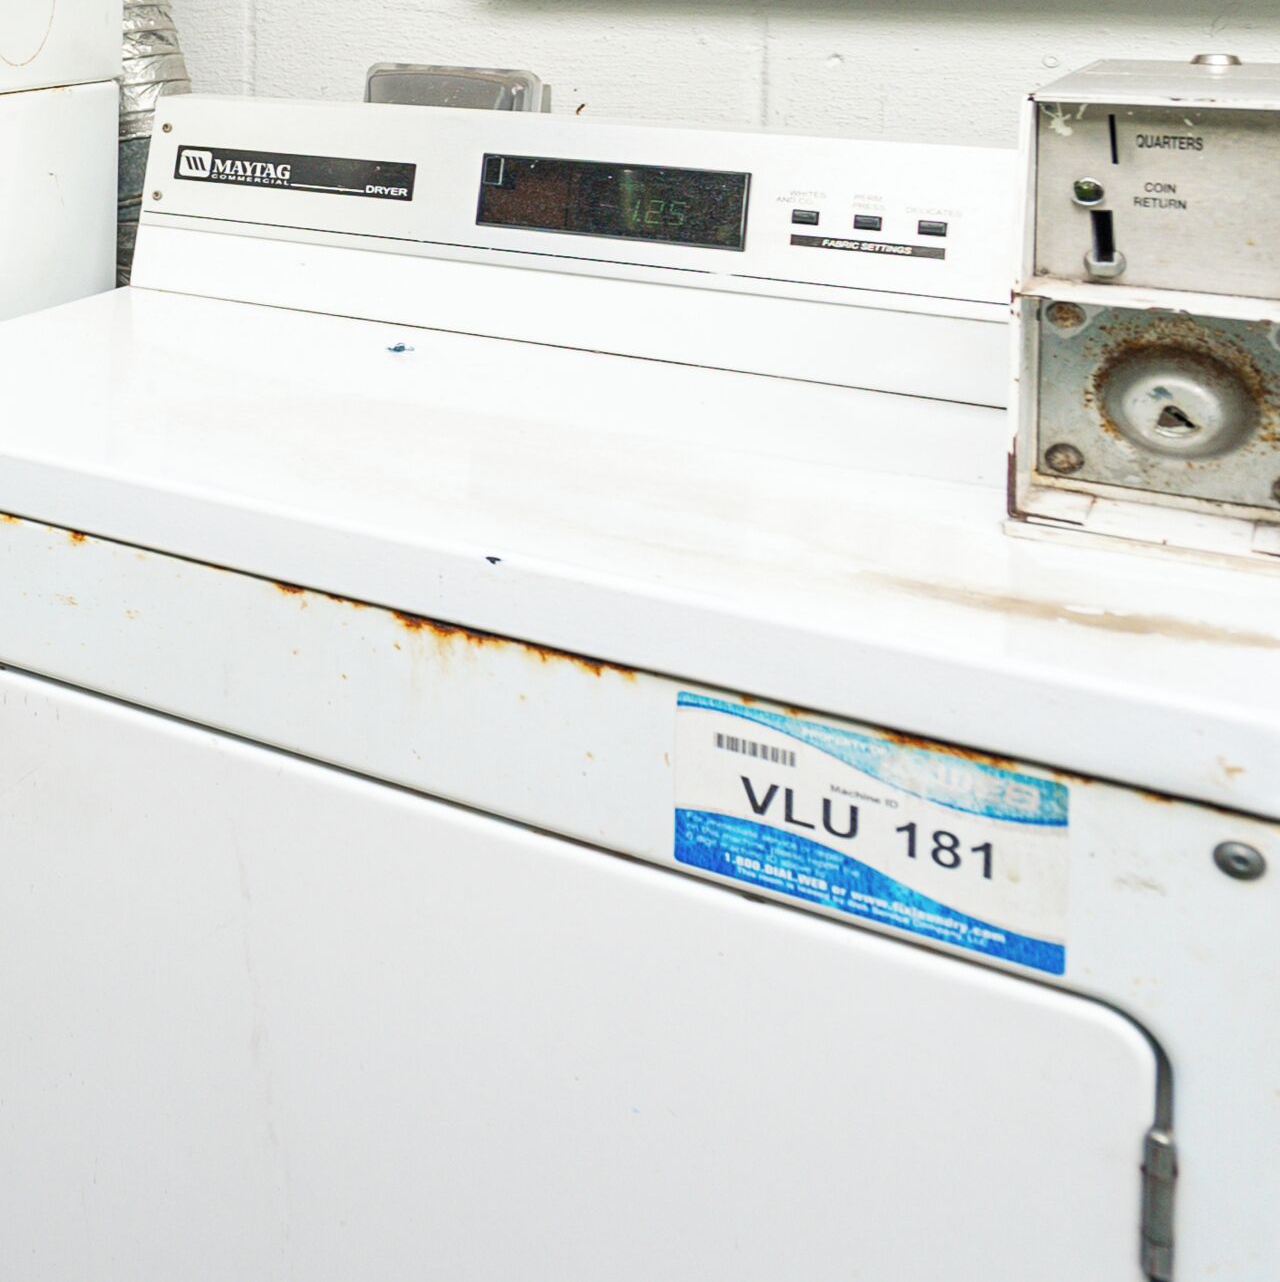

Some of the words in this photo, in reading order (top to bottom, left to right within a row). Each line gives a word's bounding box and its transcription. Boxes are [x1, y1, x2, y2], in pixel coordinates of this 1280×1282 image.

[1135, 133, 1204, 152] QUARTERS
[211, 159, 291, 180] MAYTAG
[211, 173, 289, 187] COMMERCIAL
[365, 185, 408, 197] DRYER
[1144, 182, 1177, 194] COIN
[1133, 196, 1187, 210] RETURN
[822, 238, 859, 251] FABRIC
[860, 242, 913, 255] SETTINGS
[830, 783, 881, 806] Machine
[885, 798, 898, 809] ID
[740, 775, 859, 840] VLU
[895, 821, 994, 880] 181
